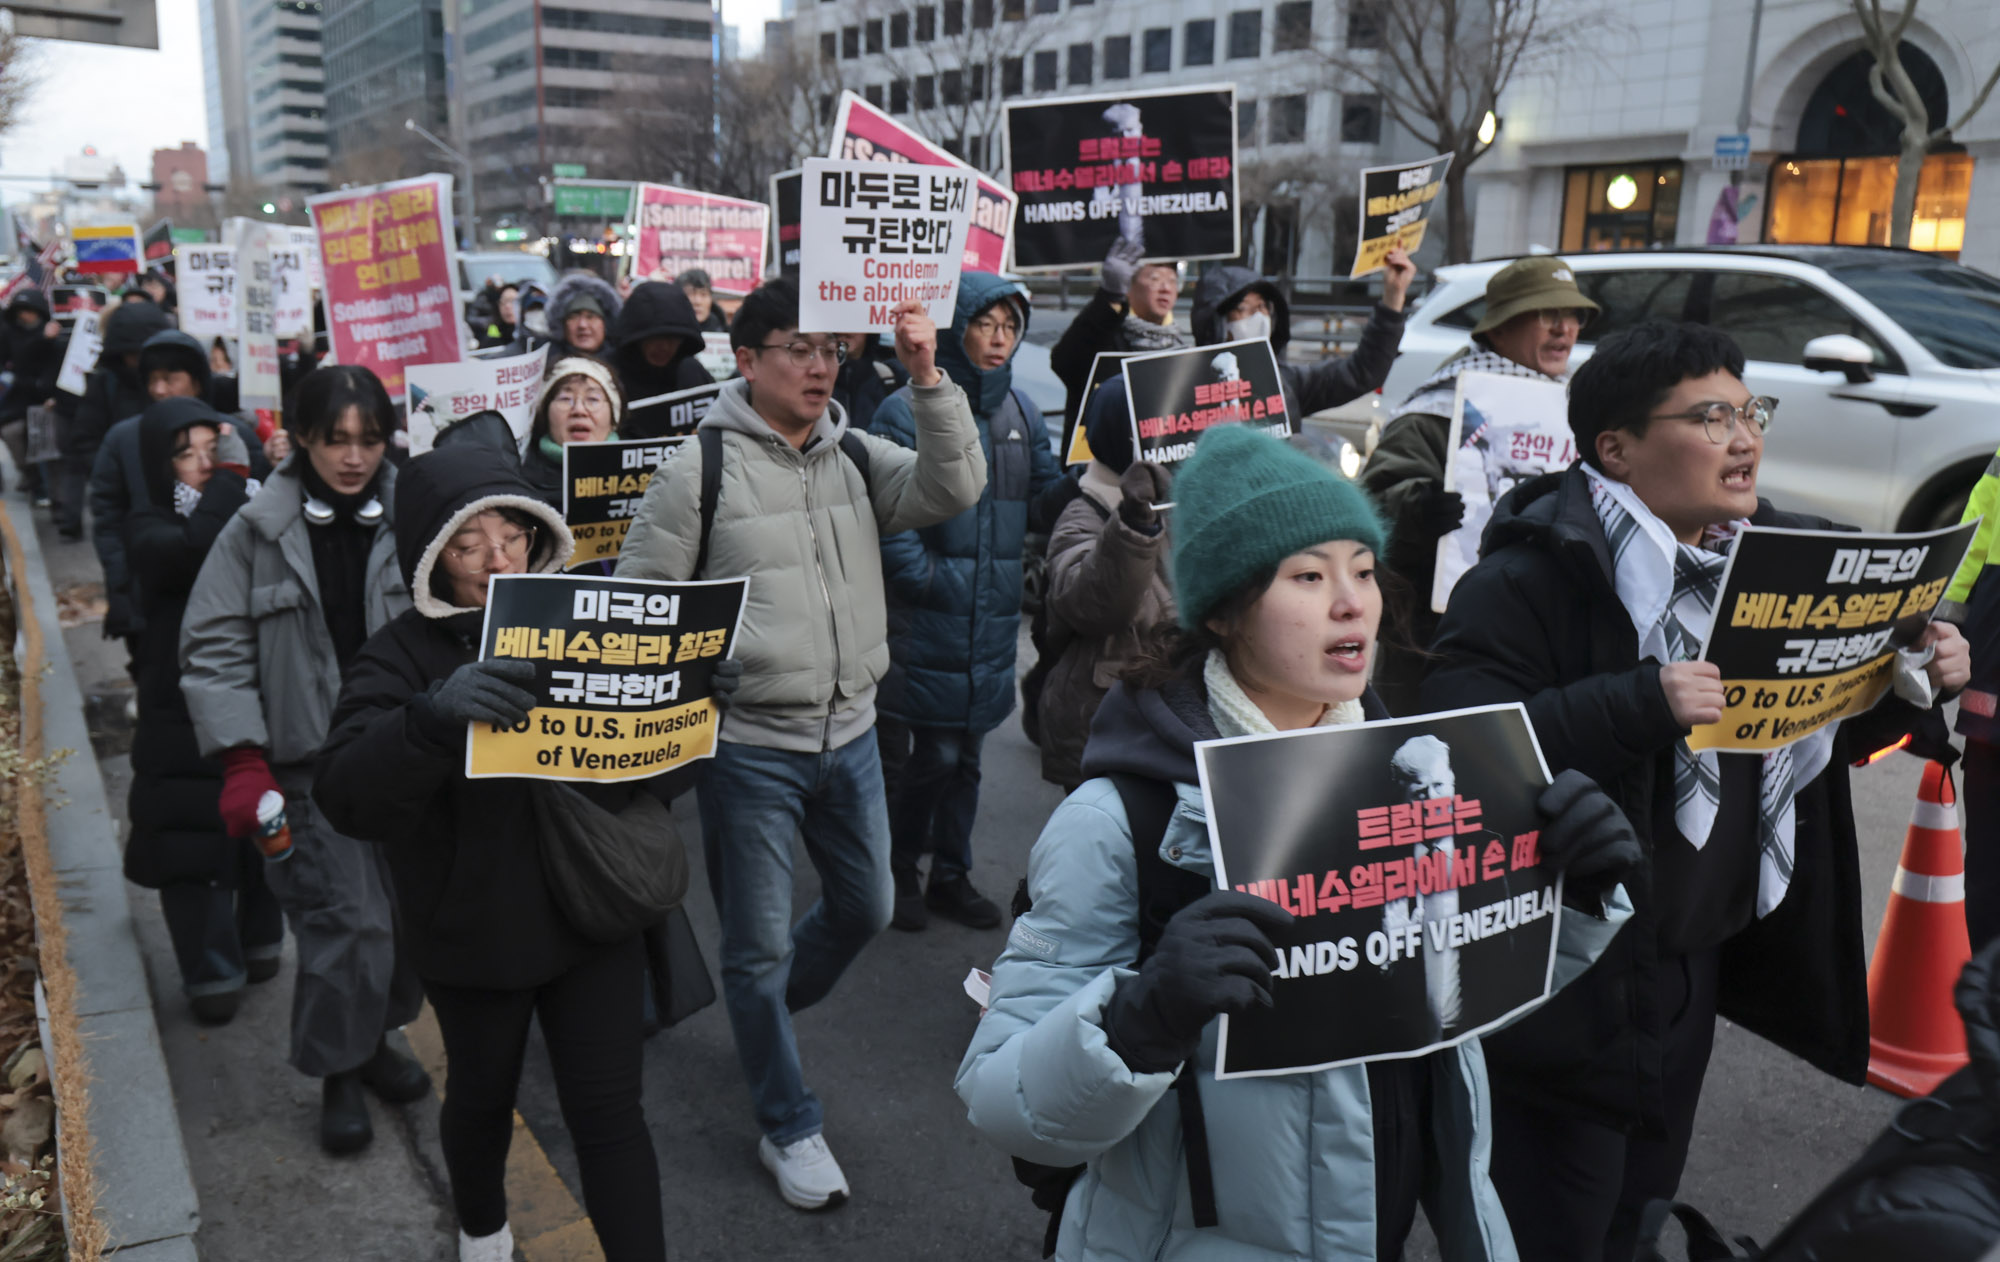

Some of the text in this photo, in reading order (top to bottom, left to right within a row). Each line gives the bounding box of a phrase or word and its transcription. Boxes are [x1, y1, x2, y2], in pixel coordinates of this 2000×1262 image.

[820, 171, 921, 211] 마두로
[930, 175, 968, 213] 납치
[1024, 200, 1086, 224] HANDS
[1089, 196, 1123, 219] OFF
[1125, 191, 1229, 216] VENEZUELA
[659, 229, 707, 252] para
[842, 216, 952, 255] 규탄한다
[190, 252, 237, 270] 마두
[863, 258, 939, 280] Condemn
[333, 285, 449, 322] Solidarity with
[818, 280, 953, 302] the abduction of
[451, 393, 488, 415] 장악
[495, 390, 521, 411] 시도
[1143, 442, 1196, 465] HANDS
[1511, 432, 1554, 463] 장악
[573, 526, 596, 540] NO
[600, 525, 615, 537] to
[596, 541, 611, 554] of
[1826, 545, 1930, 585] 미국의
[573, 589, 681, 626] 미국의
[1730, 576, 1949, 630] 베네수엘라 침공
[494, 627, 727, 666] 베네수엘라 침공
[1776, 627, 1895, 674] 규탄한다
[550, 671, 681, 706] 규탄한다
[1722, 685, 1747, 708] O
[1752, 687, 1779, 709] to
[1785, 682, 1826, 709] U.S.
[540, 714, 566, 736] to
[575, 716, 625, 740] U.S.
[634, 708, 708, 739] invasion
[1735, 722, 1767, 740] of
[536, 741, 681, 770] of Venezuela
[1357, 794, 1483, 851] 트럼프는
[1481, 839, 1506, 882] 손
[1510, 830, 1541, 872] 떼
[1270, 885, 1555, 980] ANDS OFF VENEZUELA
